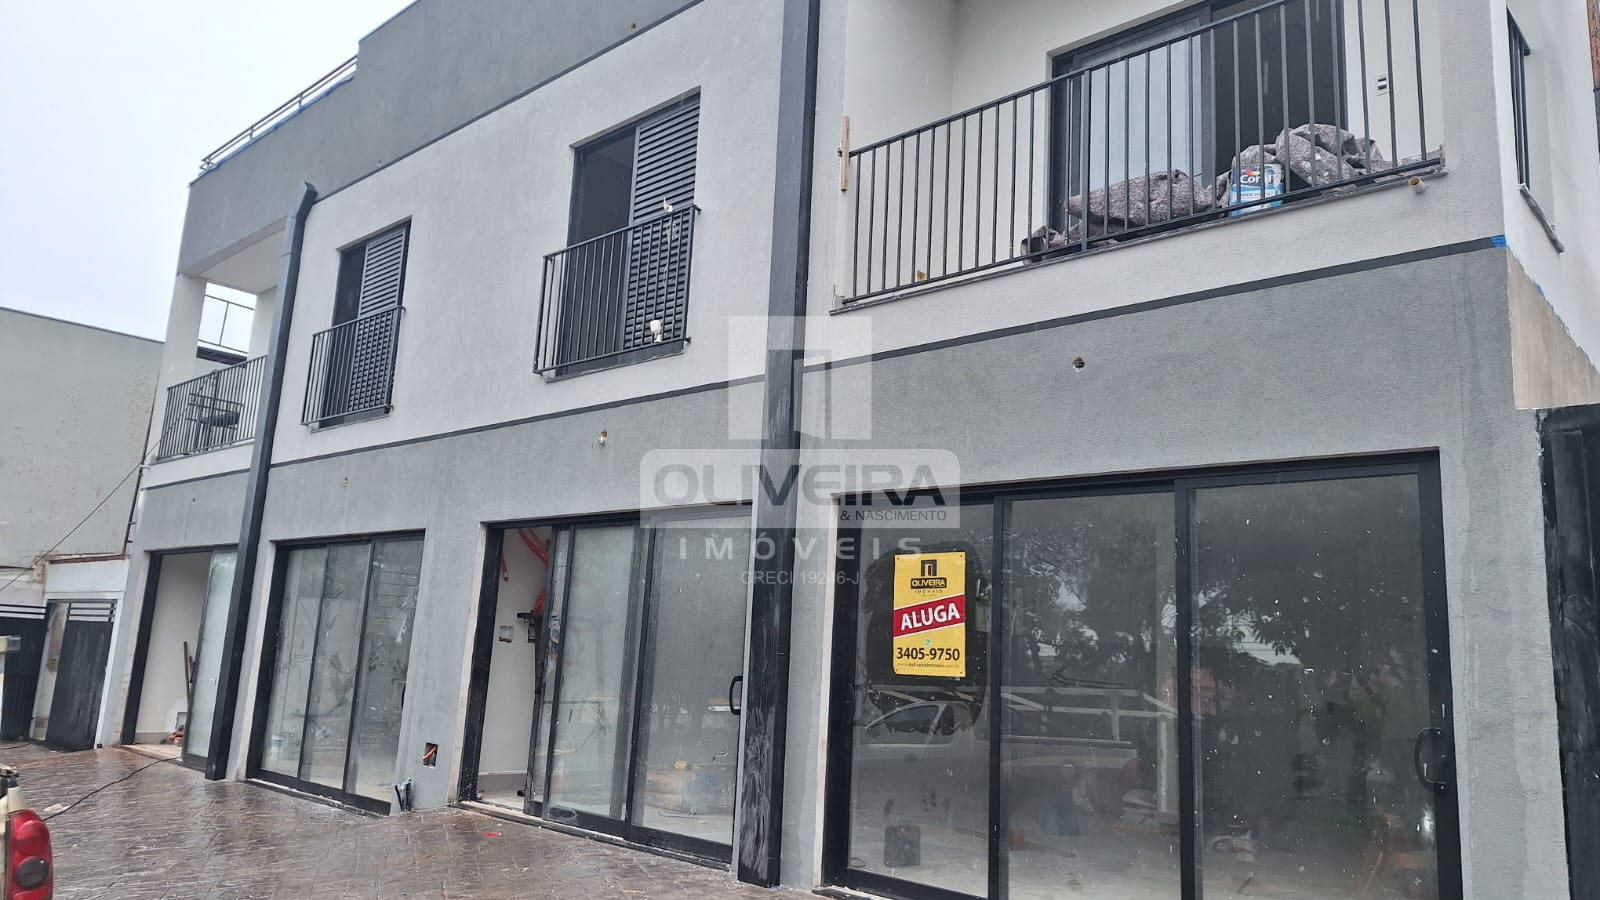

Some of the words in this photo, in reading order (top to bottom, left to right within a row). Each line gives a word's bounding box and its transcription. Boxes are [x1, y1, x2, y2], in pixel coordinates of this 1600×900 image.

[911, 578, 946, 588] OLIVEIRA
[900, 602, 961, 631] ALUGA
[896, 647, 961, 661] 3405-9750
